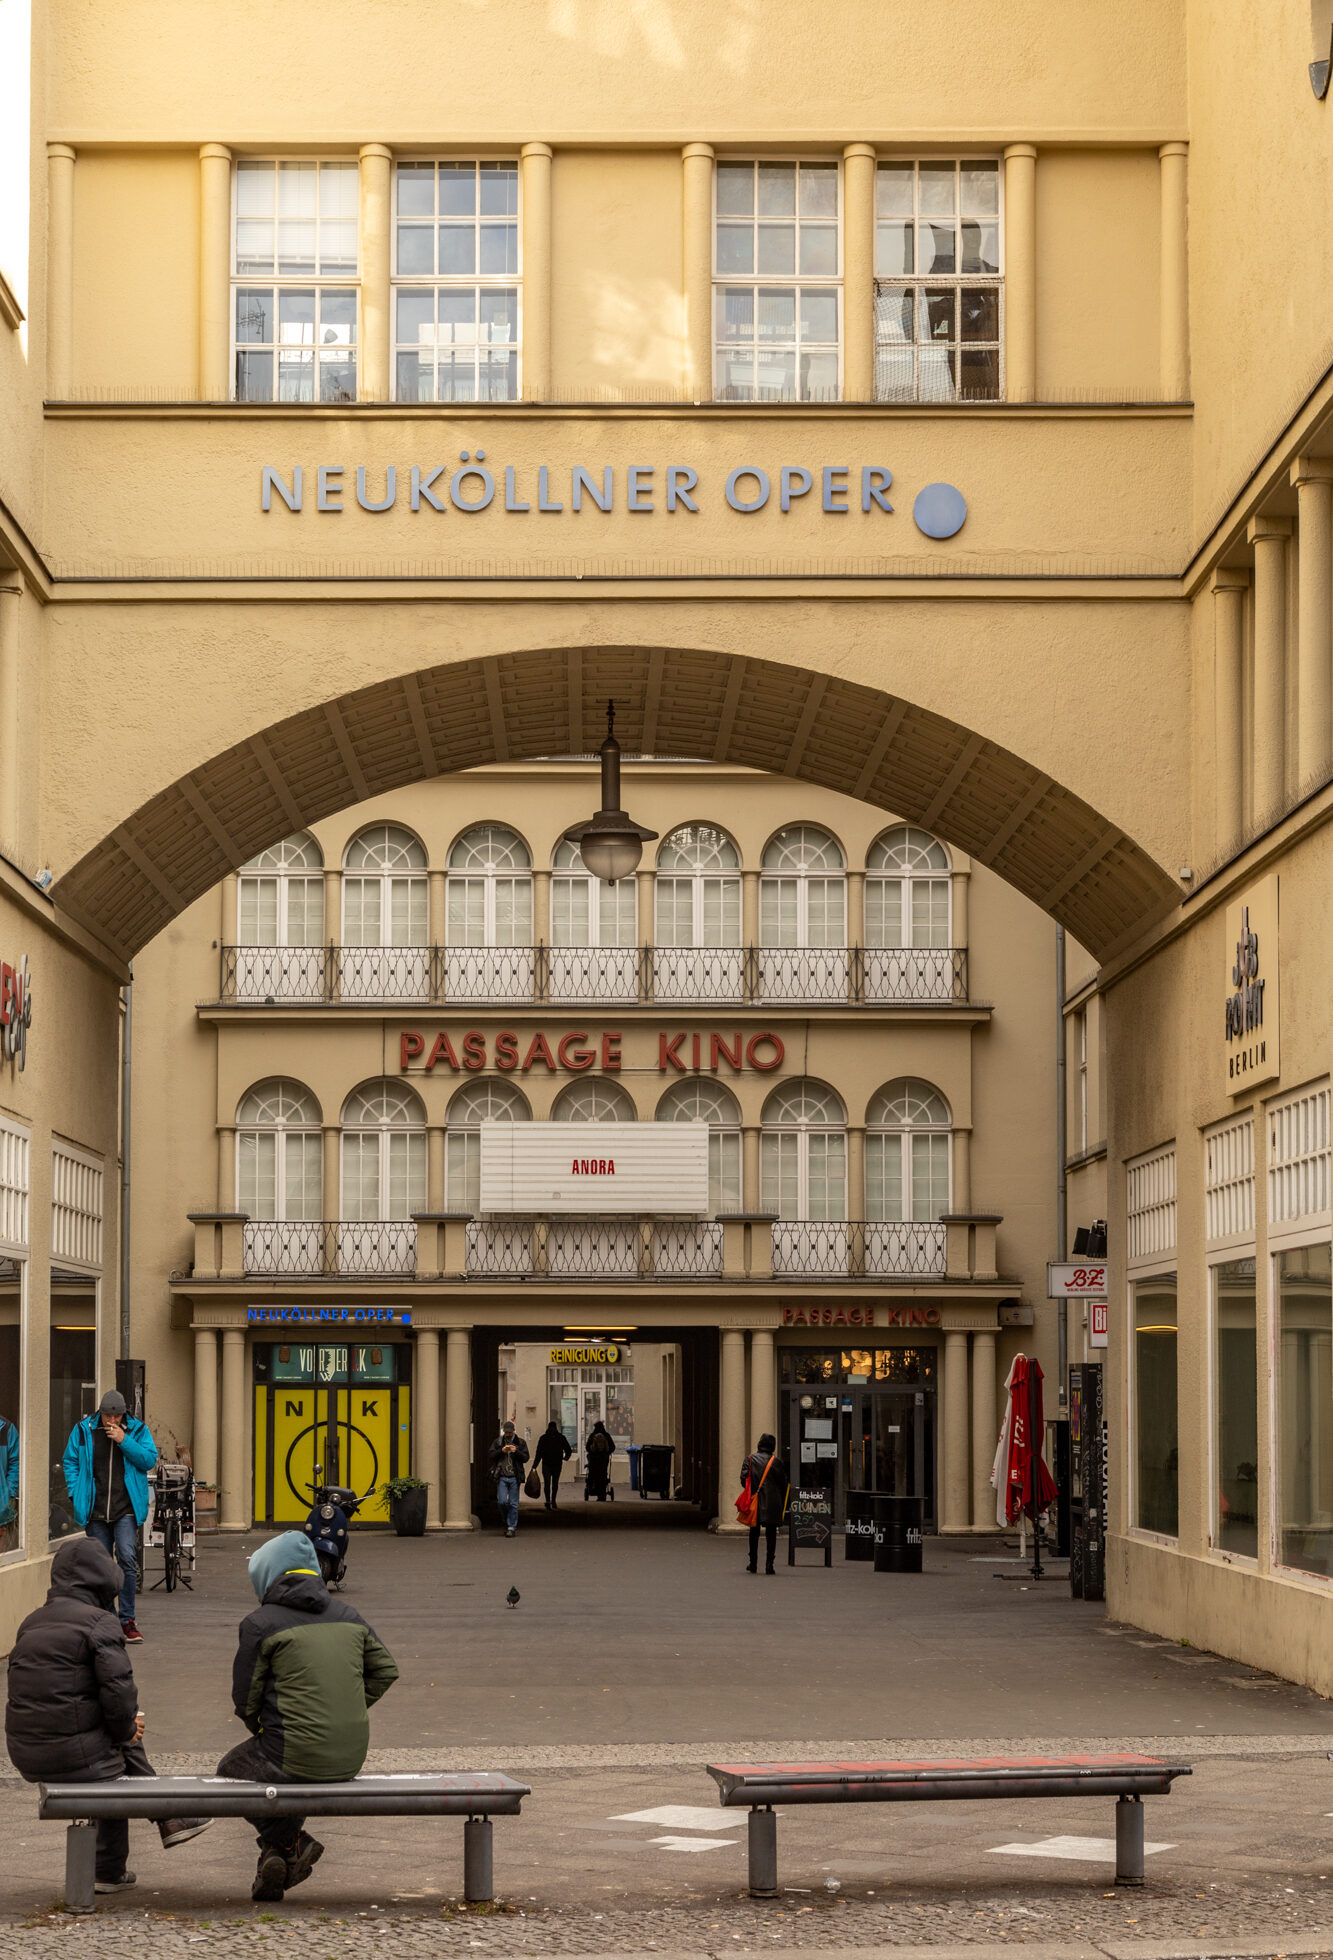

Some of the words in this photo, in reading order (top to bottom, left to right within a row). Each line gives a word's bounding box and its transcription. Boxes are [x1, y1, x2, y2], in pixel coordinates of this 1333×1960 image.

[262, 450, 700, 512] NEUKÖLLNER
[725, 465, 895, 512] OPER
[401, 1032, 623, 1071] PASSAGE
[659, 1032, 786, 1071] KINO
[1229, 1041, 1266, 1079] BERLIN
[572, 1159, 615, 1175] ANORA
[248, 1307, 349, 1321] NEUKÖLLNER
[355, 1309, 394, 1321] OPER
[783, 1307, 875, 1325] PASSAGE
[888, 1307, 940, 1325] KINO
[550, 1349, 606, 1363] REINIGUNG
